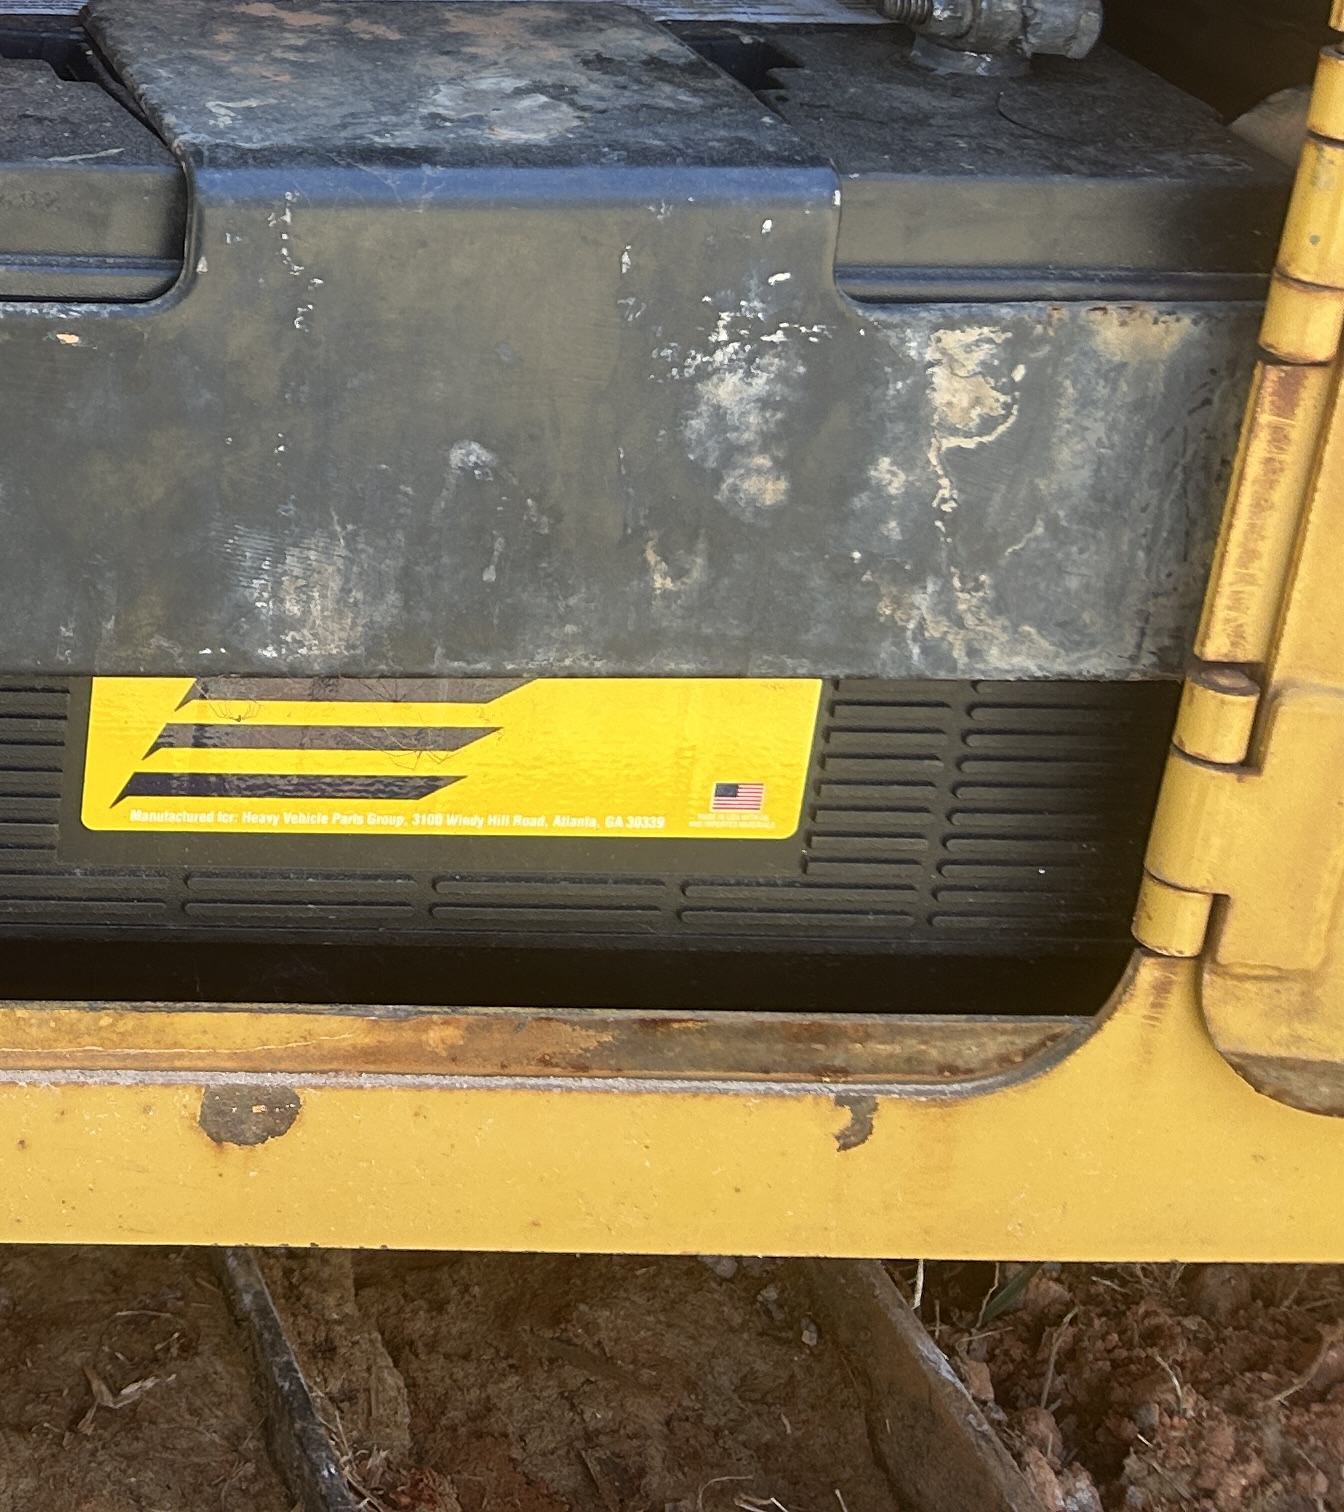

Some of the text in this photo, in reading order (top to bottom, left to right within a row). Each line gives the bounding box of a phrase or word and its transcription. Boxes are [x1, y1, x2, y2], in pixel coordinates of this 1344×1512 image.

[130, 810, 215, 823] Manufactured
[242, 811, 280, 826] Heavy
[283, 811, 329, 825] Vehicle
[332, 812, 364, 825] Parts
[411, 813, 444, 826] 3100
[446, 814, 484, 828] Windy
[487, 815, 510, 826] Hill
[605, 816, 624, 828] GA
